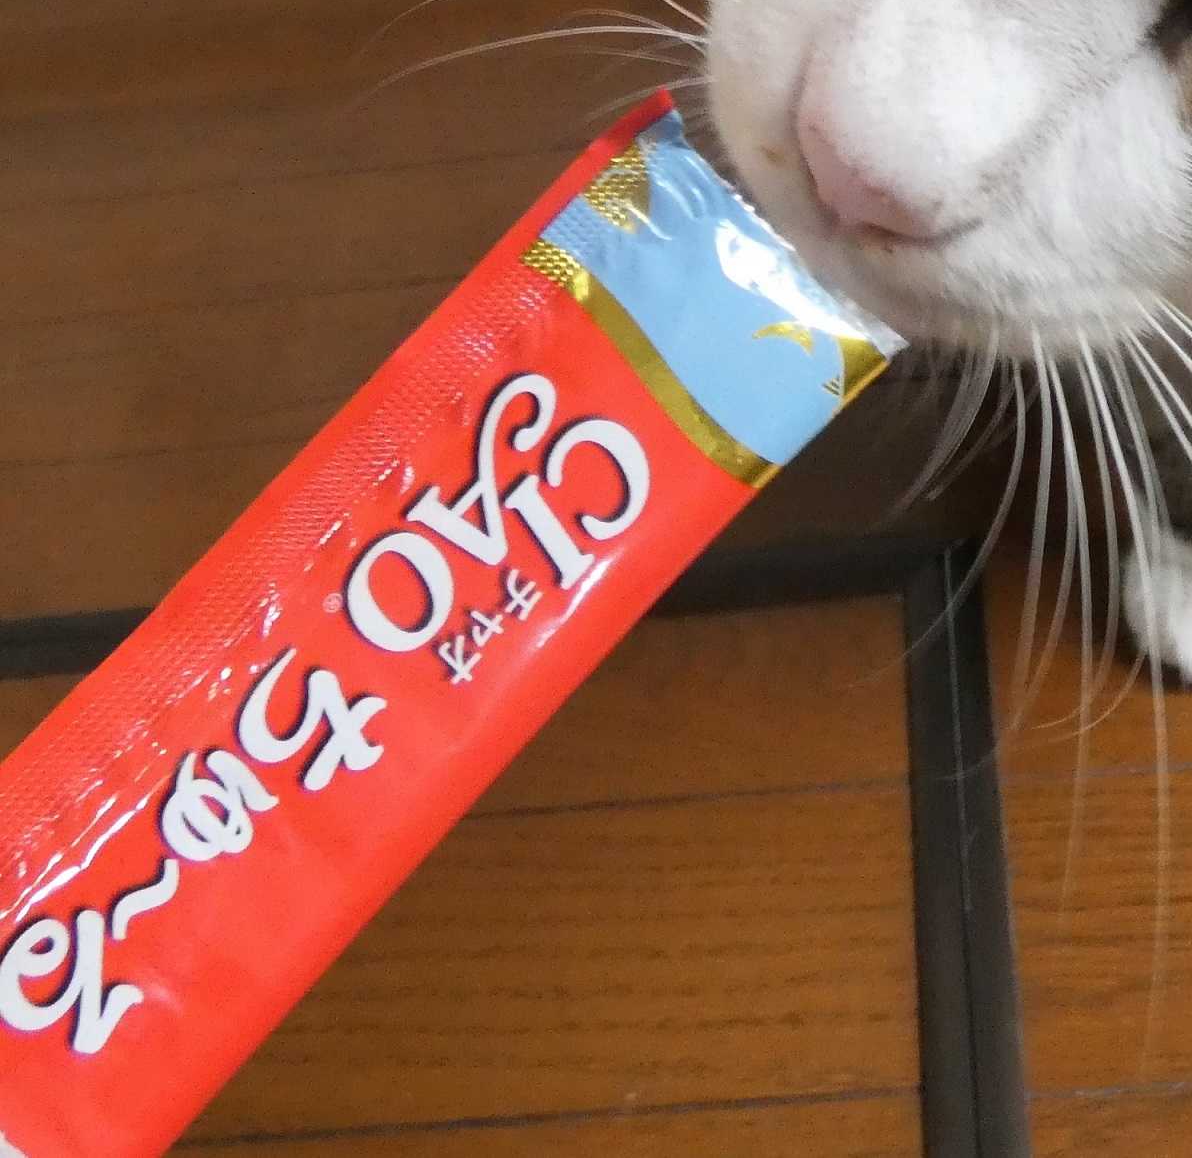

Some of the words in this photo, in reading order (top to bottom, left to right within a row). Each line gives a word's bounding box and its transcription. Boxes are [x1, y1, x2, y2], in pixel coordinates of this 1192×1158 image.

[345, 374, 649, 653] CIAO
[437, 569, 543, 684] チャオ
